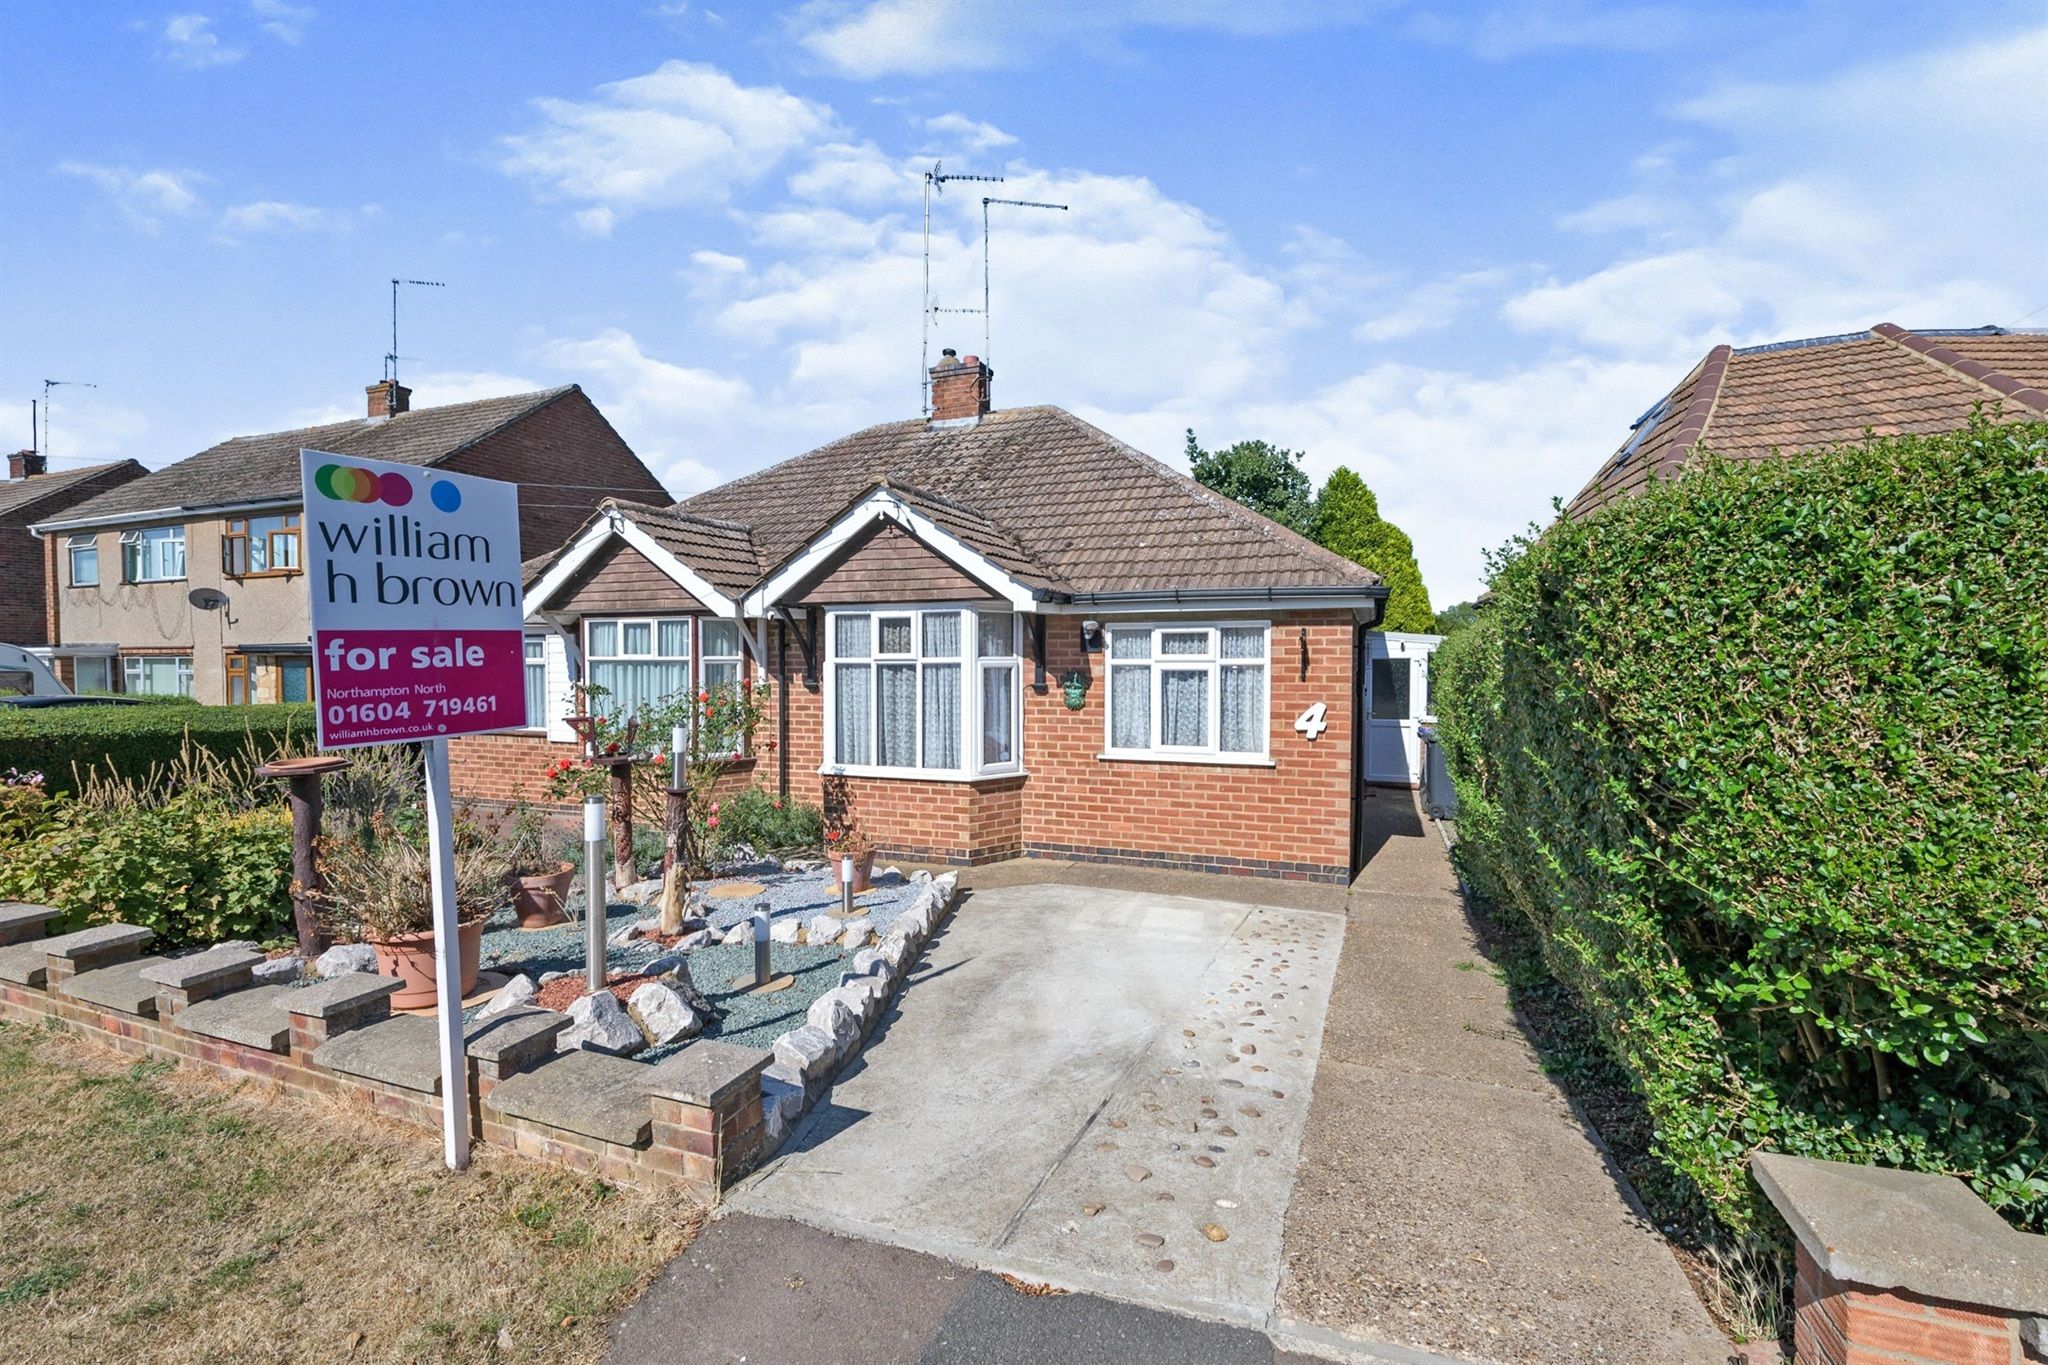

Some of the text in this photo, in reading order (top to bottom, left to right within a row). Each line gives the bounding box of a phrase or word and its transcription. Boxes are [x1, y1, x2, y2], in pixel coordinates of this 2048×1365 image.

[318, 514, 490, 563] william
[326, 559, 516, 607] h brown
[324, 638, 485, 672] for sale
[326, 682, 446, 699] Northampton North
[328, 695, 497, 725] 01604 719461
[1293, 701, 1328, 741] 4
[329, 722, 434, 741] williamhbrown.co.uk
